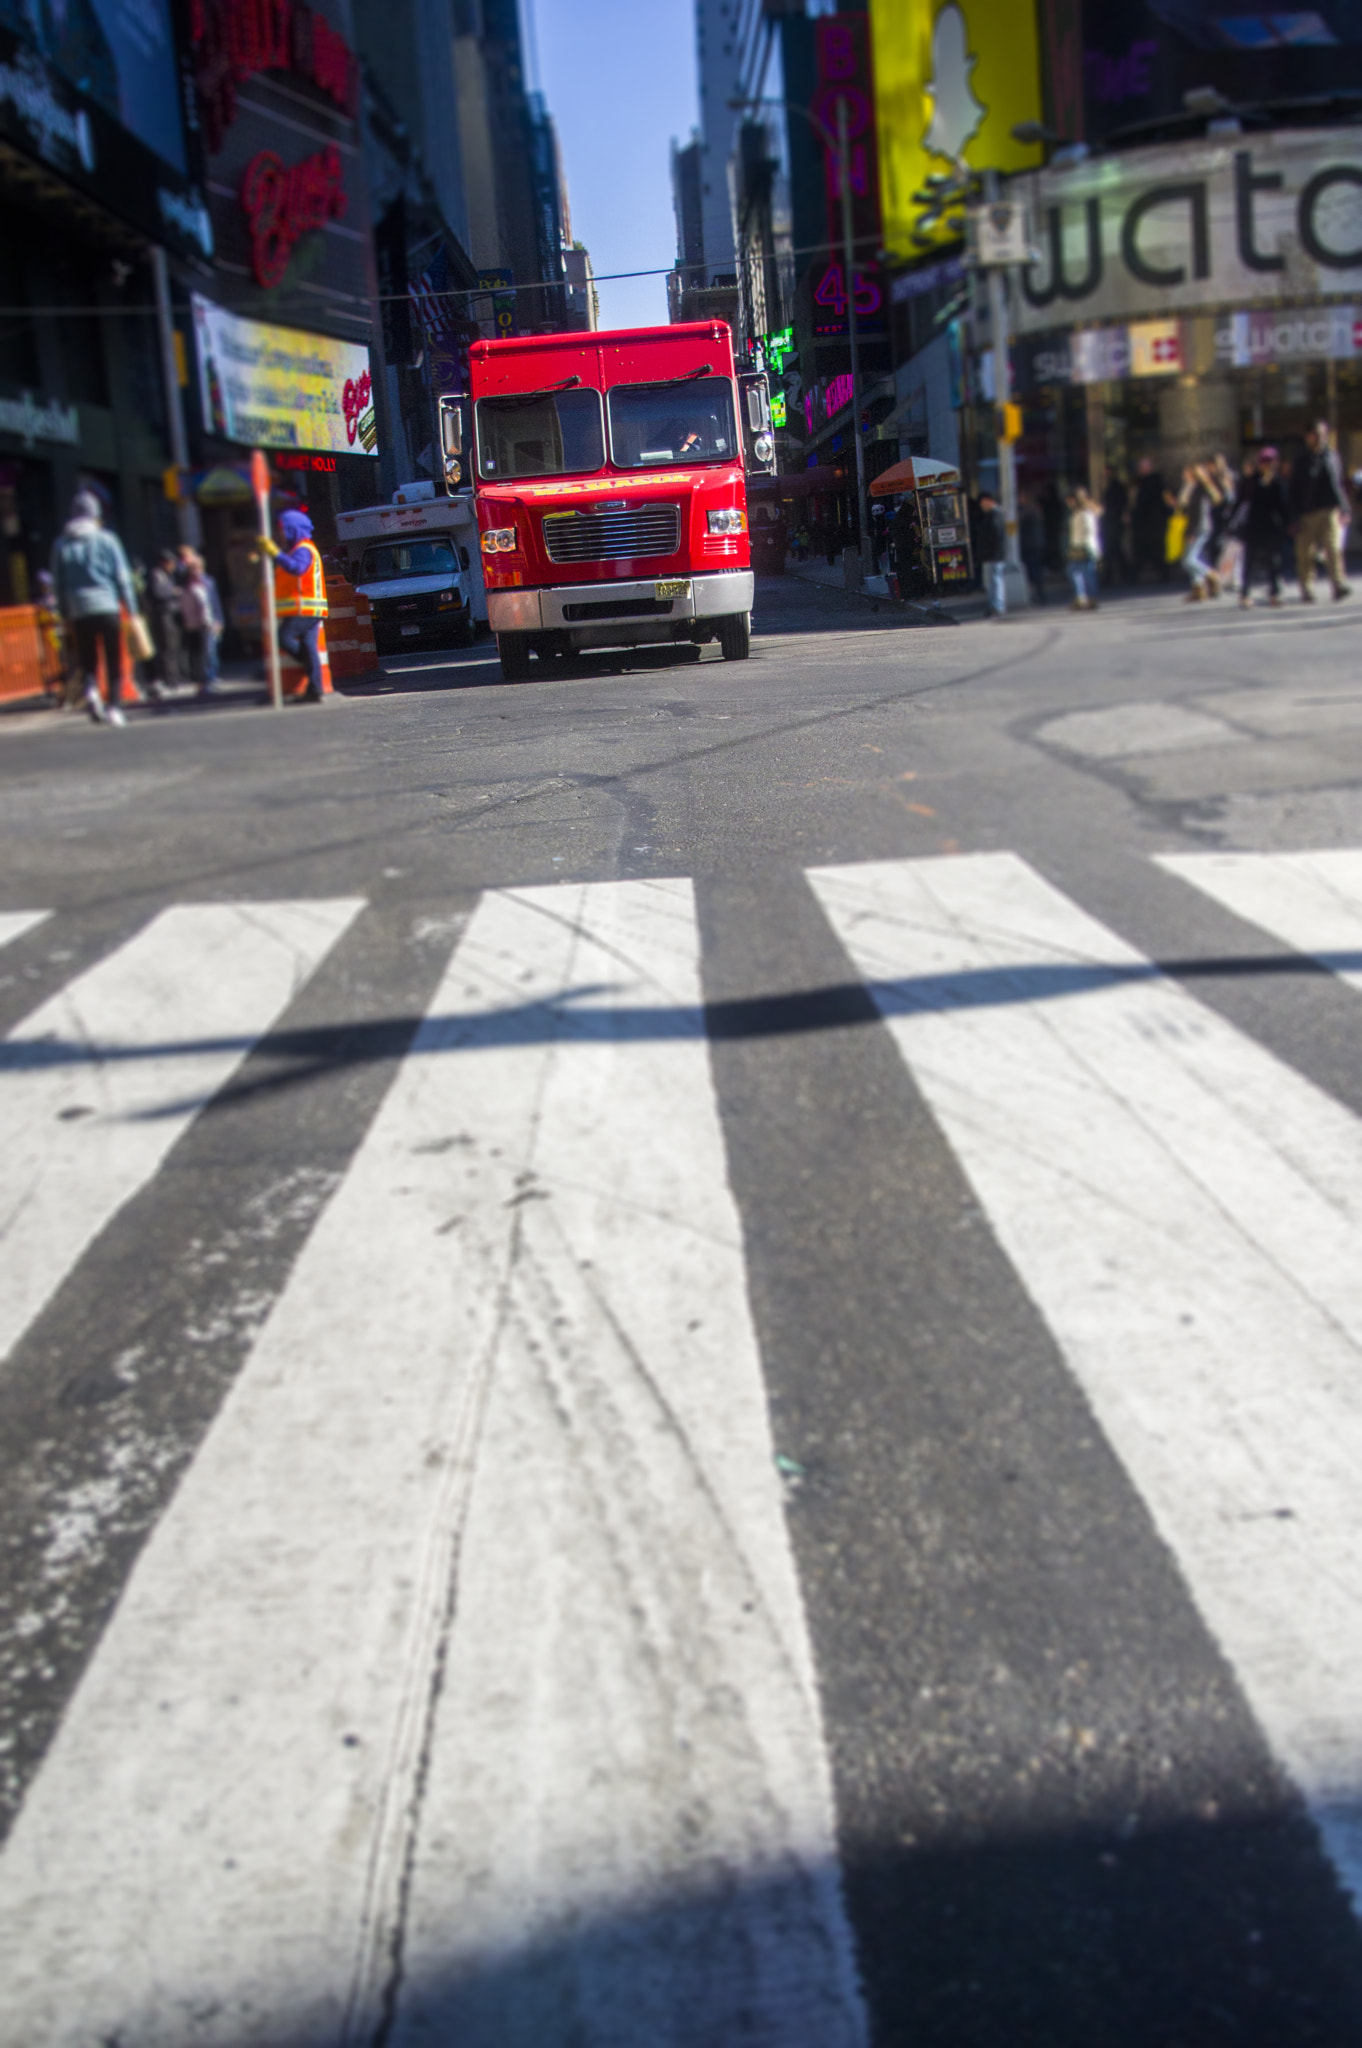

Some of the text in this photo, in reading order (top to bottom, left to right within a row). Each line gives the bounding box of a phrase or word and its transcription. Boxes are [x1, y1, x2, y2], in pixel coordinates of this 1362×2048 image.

[814, 263, 883, 316] 45
[311, 456, 337, 472] HOLLY
[400, 518, 427, 527] verizon
